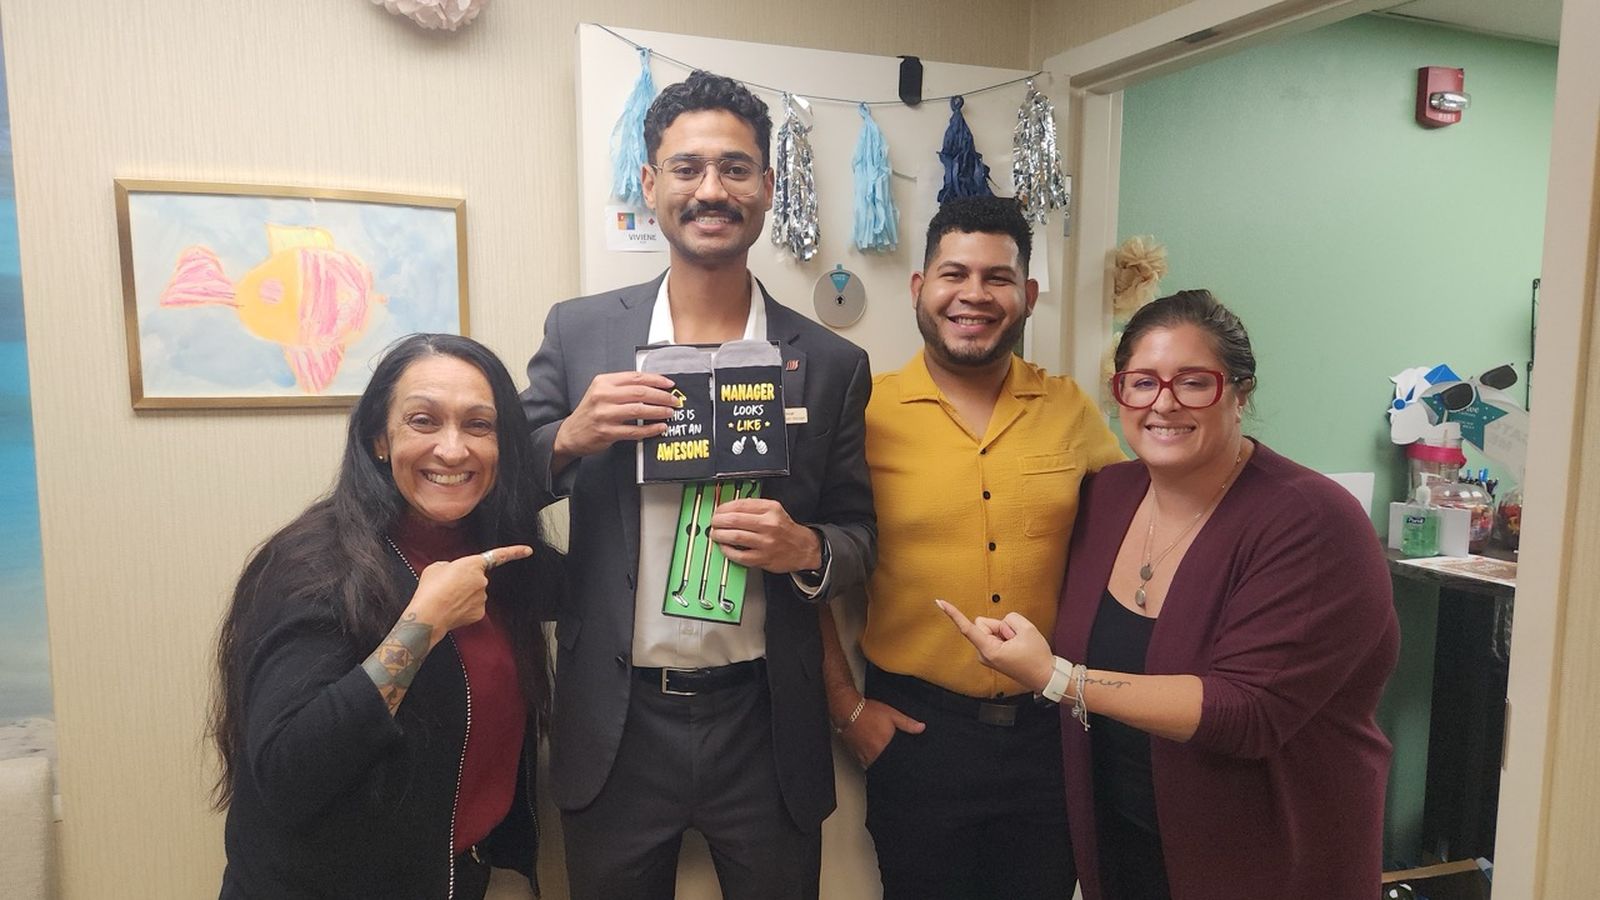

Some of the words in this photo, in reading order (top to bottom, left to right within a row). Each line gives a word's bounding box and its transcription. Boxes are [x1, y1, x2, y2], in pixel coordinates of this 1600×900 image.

[721, 383, 775, 402] MANAGER
[667, 409, 685, 421] HIS
[686, 409, 696, 420] IS
[733, 404, 764, 416] LOOKS
[688, 423, 702, 436] AN
[736, 419, 762, 432] LIKE
[656, 440, 710, 461] AWESOME
